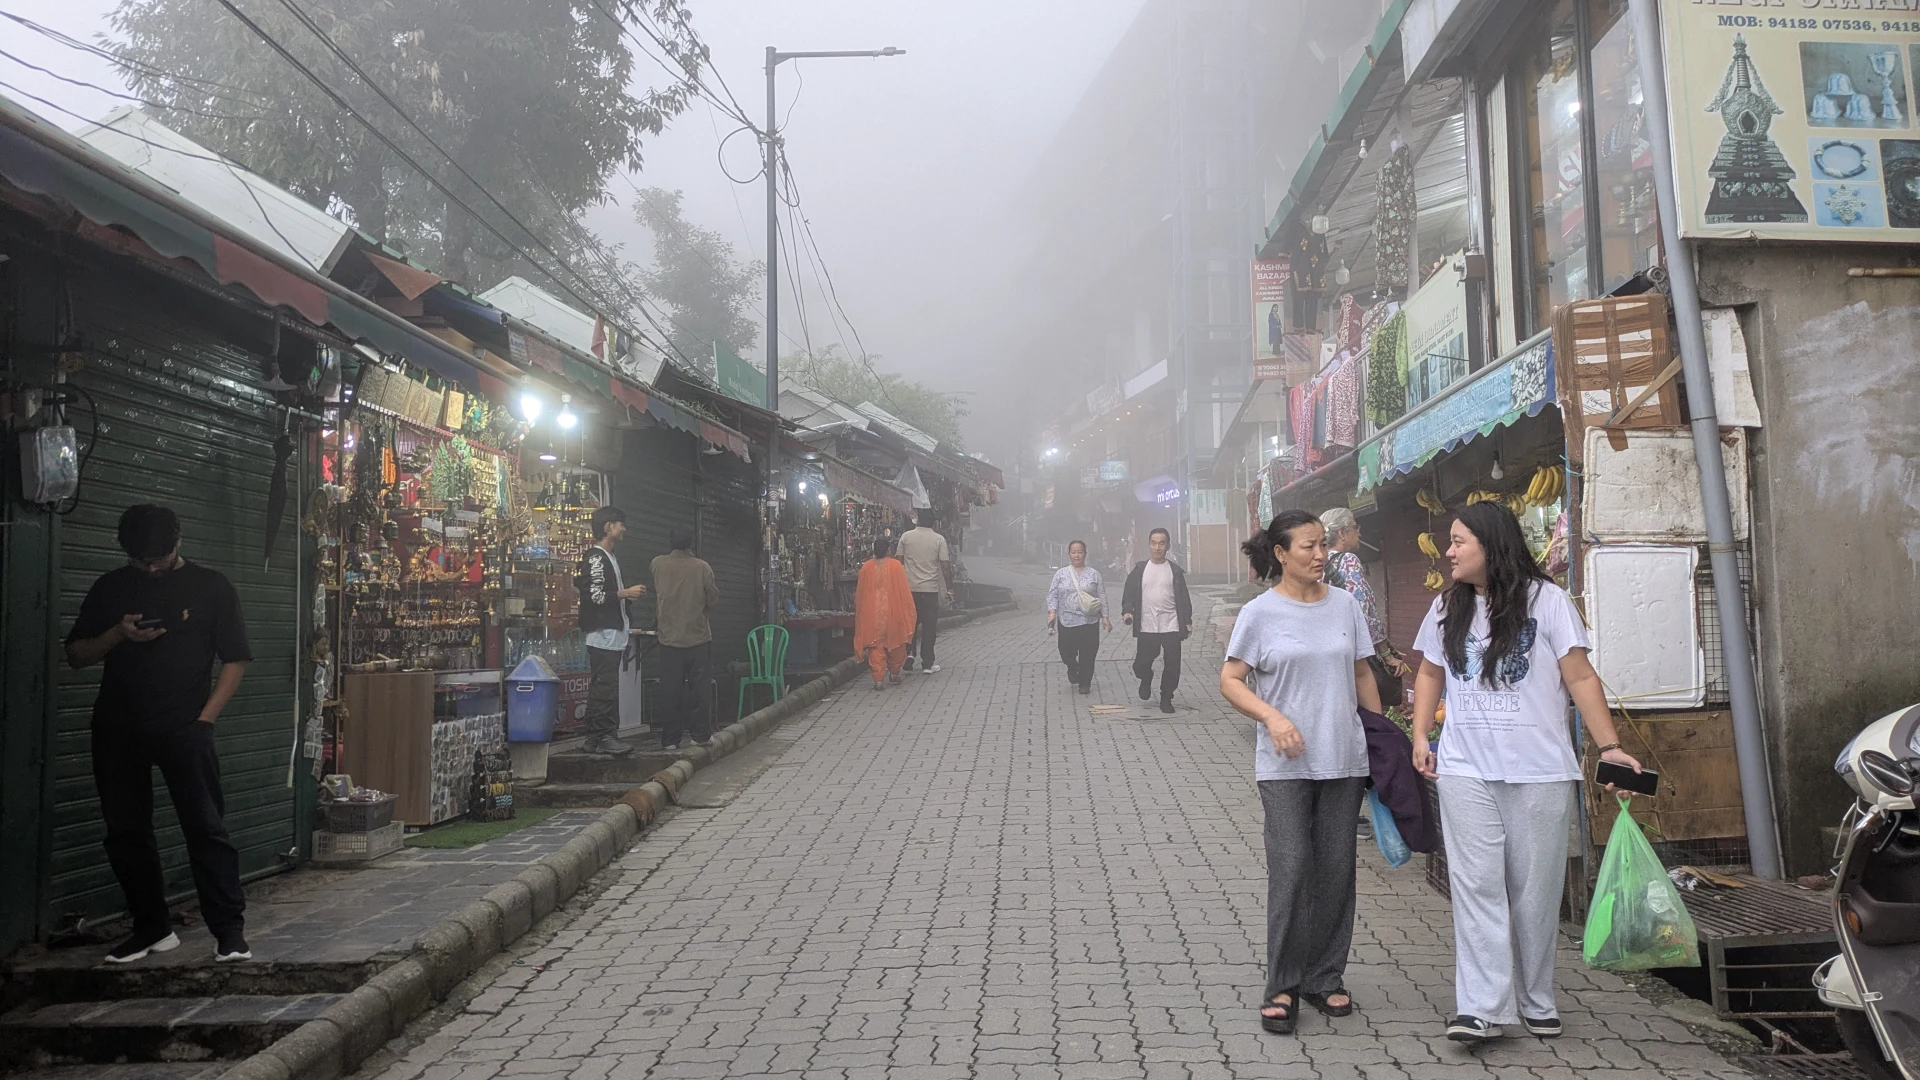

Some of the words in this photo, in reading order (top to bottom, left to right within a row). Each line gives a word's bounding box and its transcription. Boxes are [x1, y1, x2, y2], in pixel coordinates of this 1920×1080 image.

[1717, 15, 1762, 28] MOB:
[1768, 17, 1818, 29] 94182
[1822, 19, 1876, 32] 07536,
[1457, 693, 1520, 712] FREE
